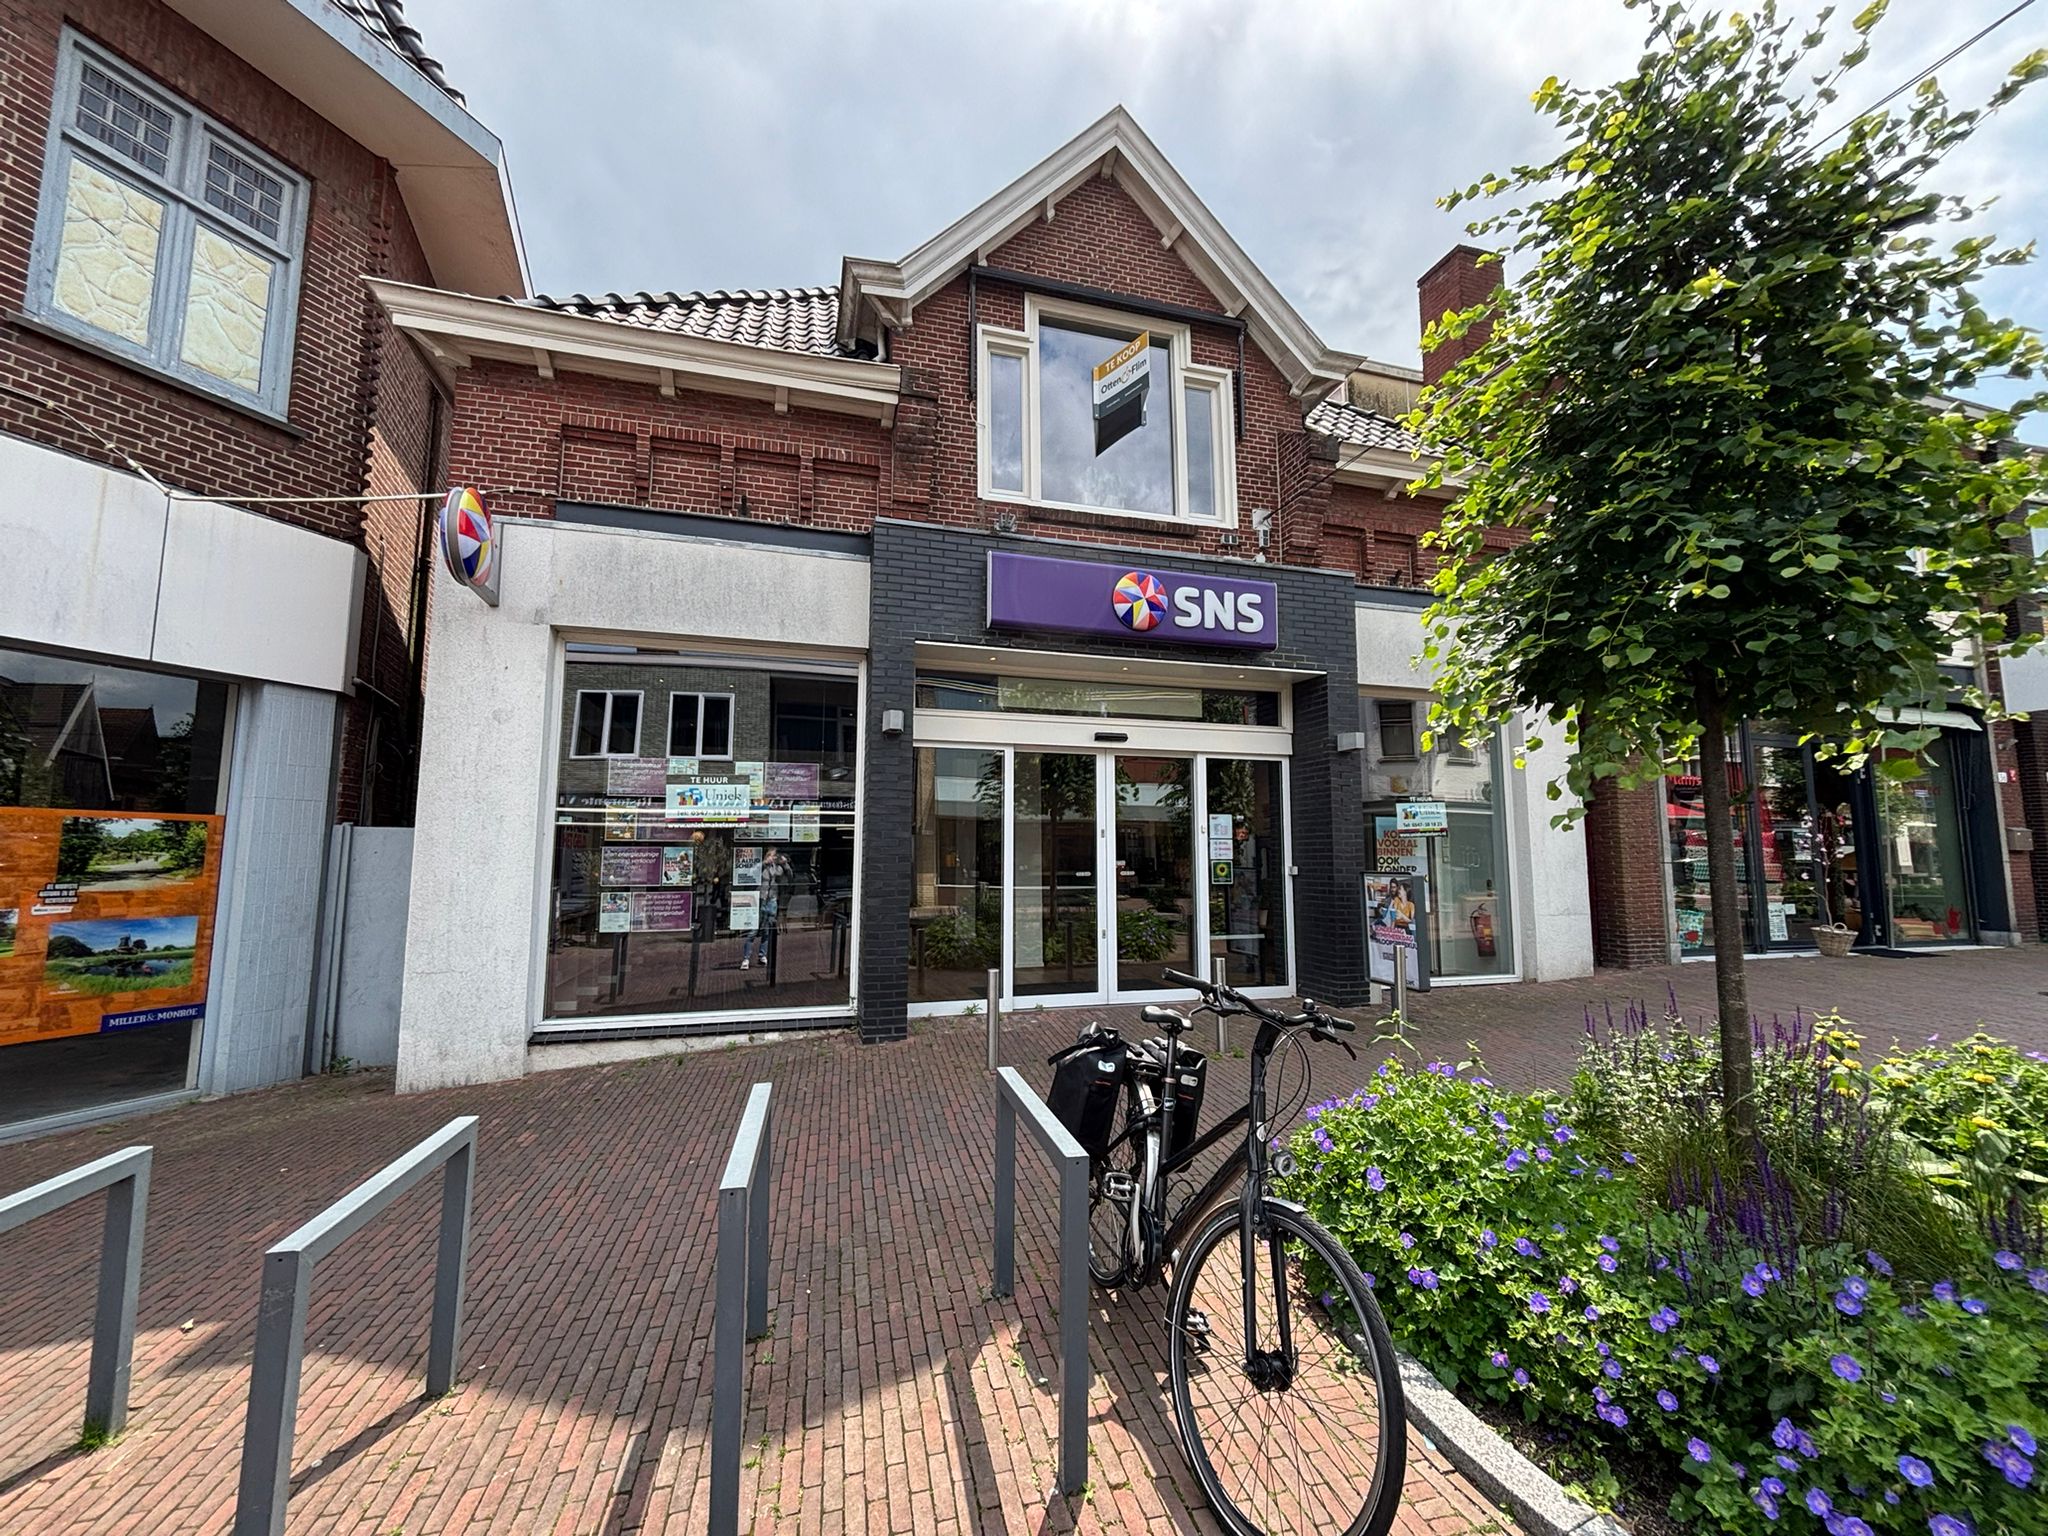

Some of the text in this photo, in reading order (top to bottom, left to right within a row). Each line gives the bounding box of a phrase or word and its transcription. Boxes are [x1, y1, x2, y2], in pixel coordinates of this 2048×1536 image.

[1105, 341, 1141, 373] TE KOOP
[1101, 377, 1121, 394] Otten
[1131, 359, 1147, 375] Flim
[1174, 586, 1264, 633] SNS
[703, 776, 728, 784] HUUR
[705, 787, 741, 801] Uniek
[1377, 839, 1418, 848] VOORAL
[1377, 847, 1416, 857] BINNEN.
[1378, 856, 1400, 865] OOK
[1378, 865, 1418, 873] ZONDER
[109, 1015, 147, 1027] MILLER
[157, 1008, 198, 1020] MONROE
